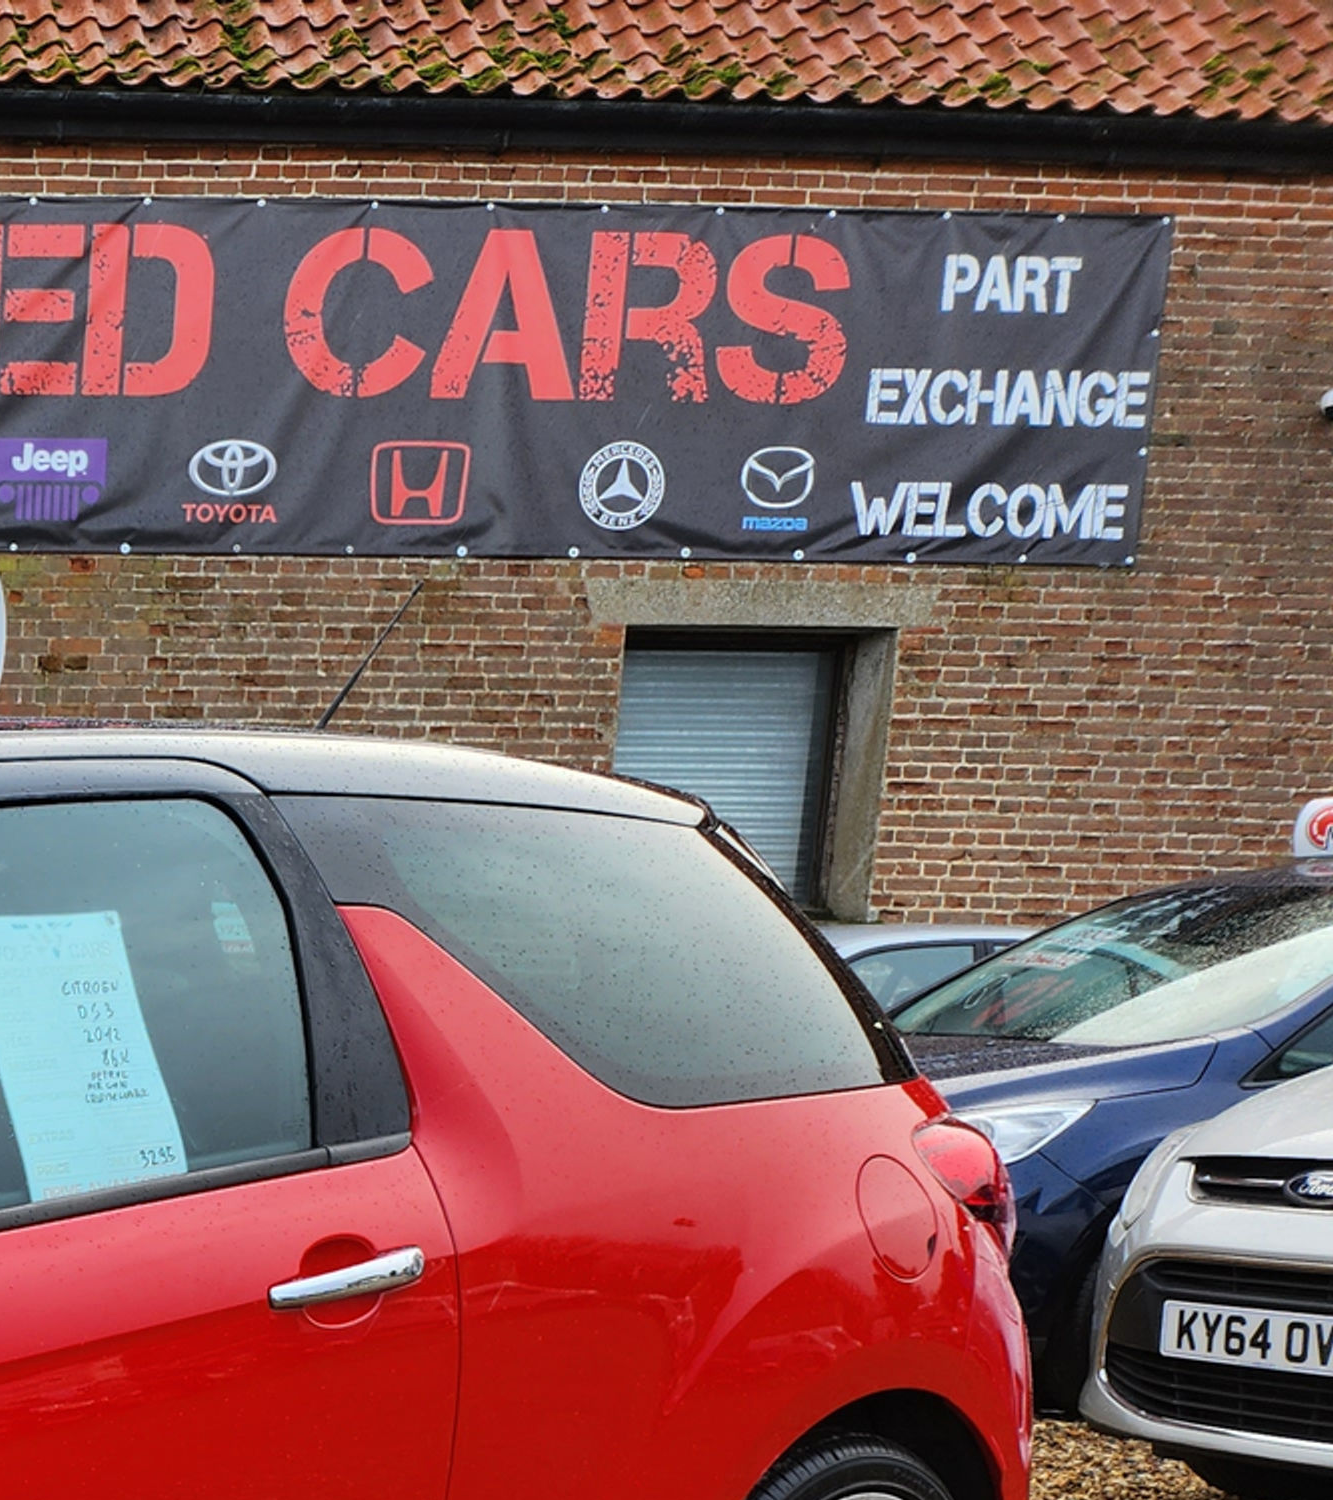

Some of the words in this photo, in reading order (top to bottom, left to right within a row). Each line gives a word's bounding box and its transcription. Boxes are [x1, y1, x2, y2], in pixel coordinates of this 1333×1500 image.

[941, 252, 1083, 315] PART
[283, 226, 852, 405] CARS
[864, 366, 1152, 429] EXCHANGE
[11, 441, 90, 477] Jeep
[181, 503, 278, 525] TOYOTA
[741, 515, 809, 532] mazda
[850, 480, 1130, 541] WELCOME
[83, 1026, 122, 1043] 2012
[1176, 1309, 1273, 1360] KY64
